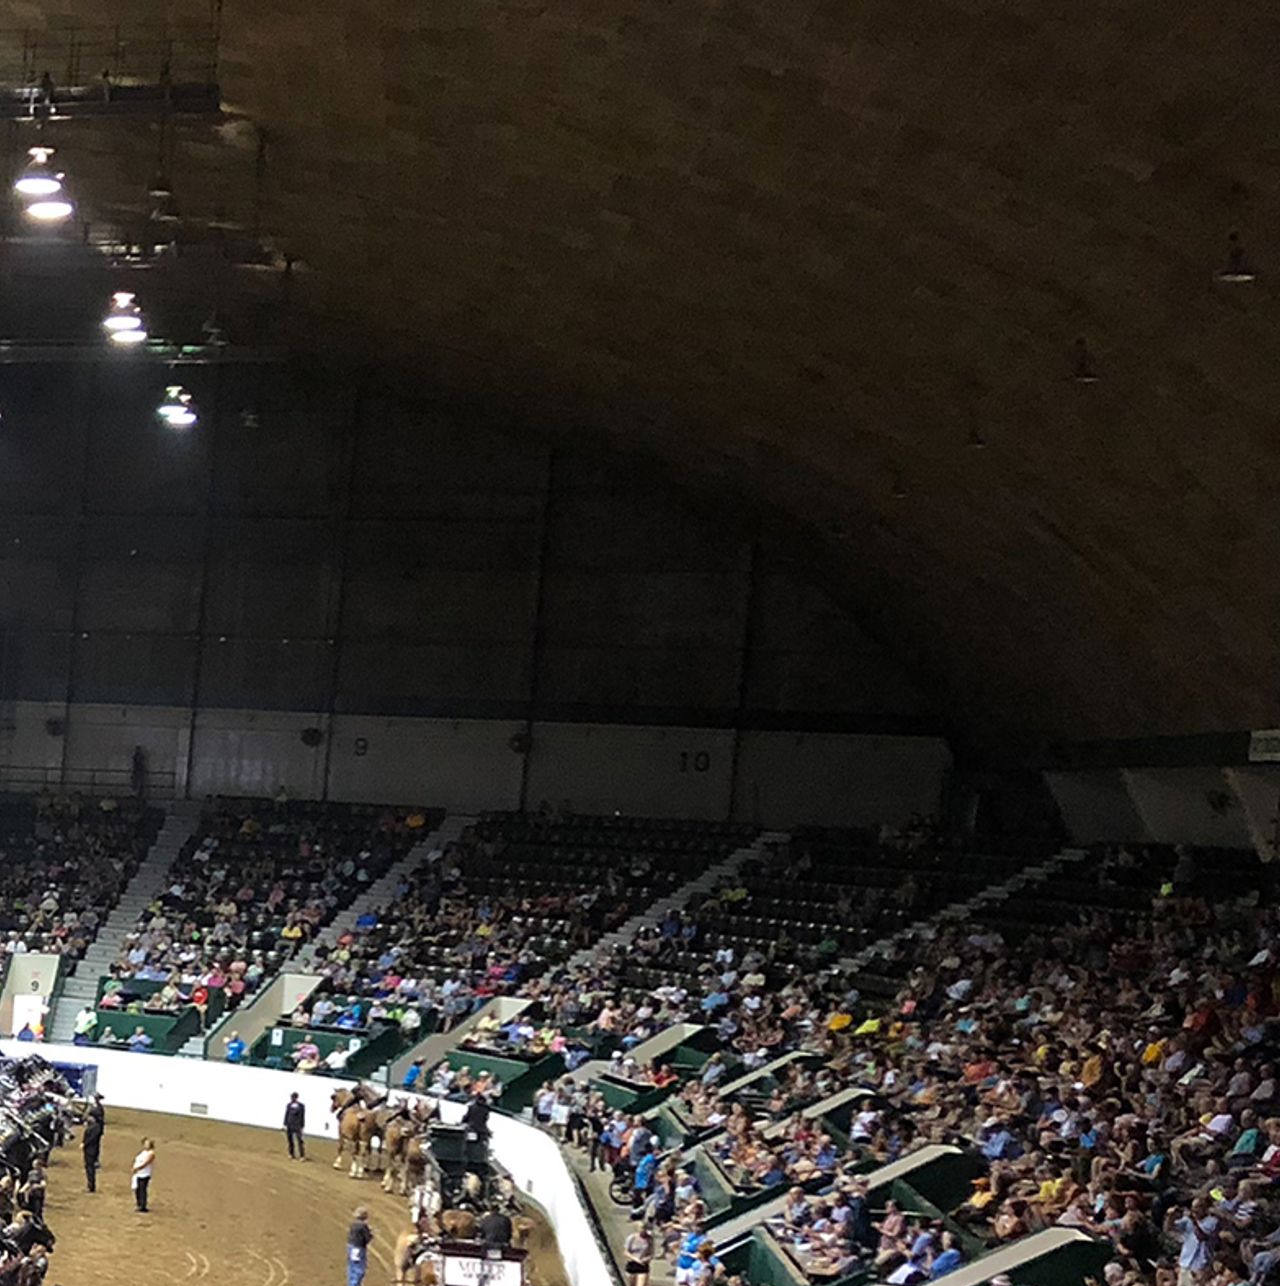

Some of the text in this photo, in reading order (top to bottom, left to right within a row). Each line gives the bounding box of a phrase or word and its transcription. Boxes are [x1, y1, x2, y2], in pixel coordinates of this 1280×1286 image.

[355, 738, 368, 756] 9
[680, 752, 709, 772] 10
[31, 980, 40, 992] 9
